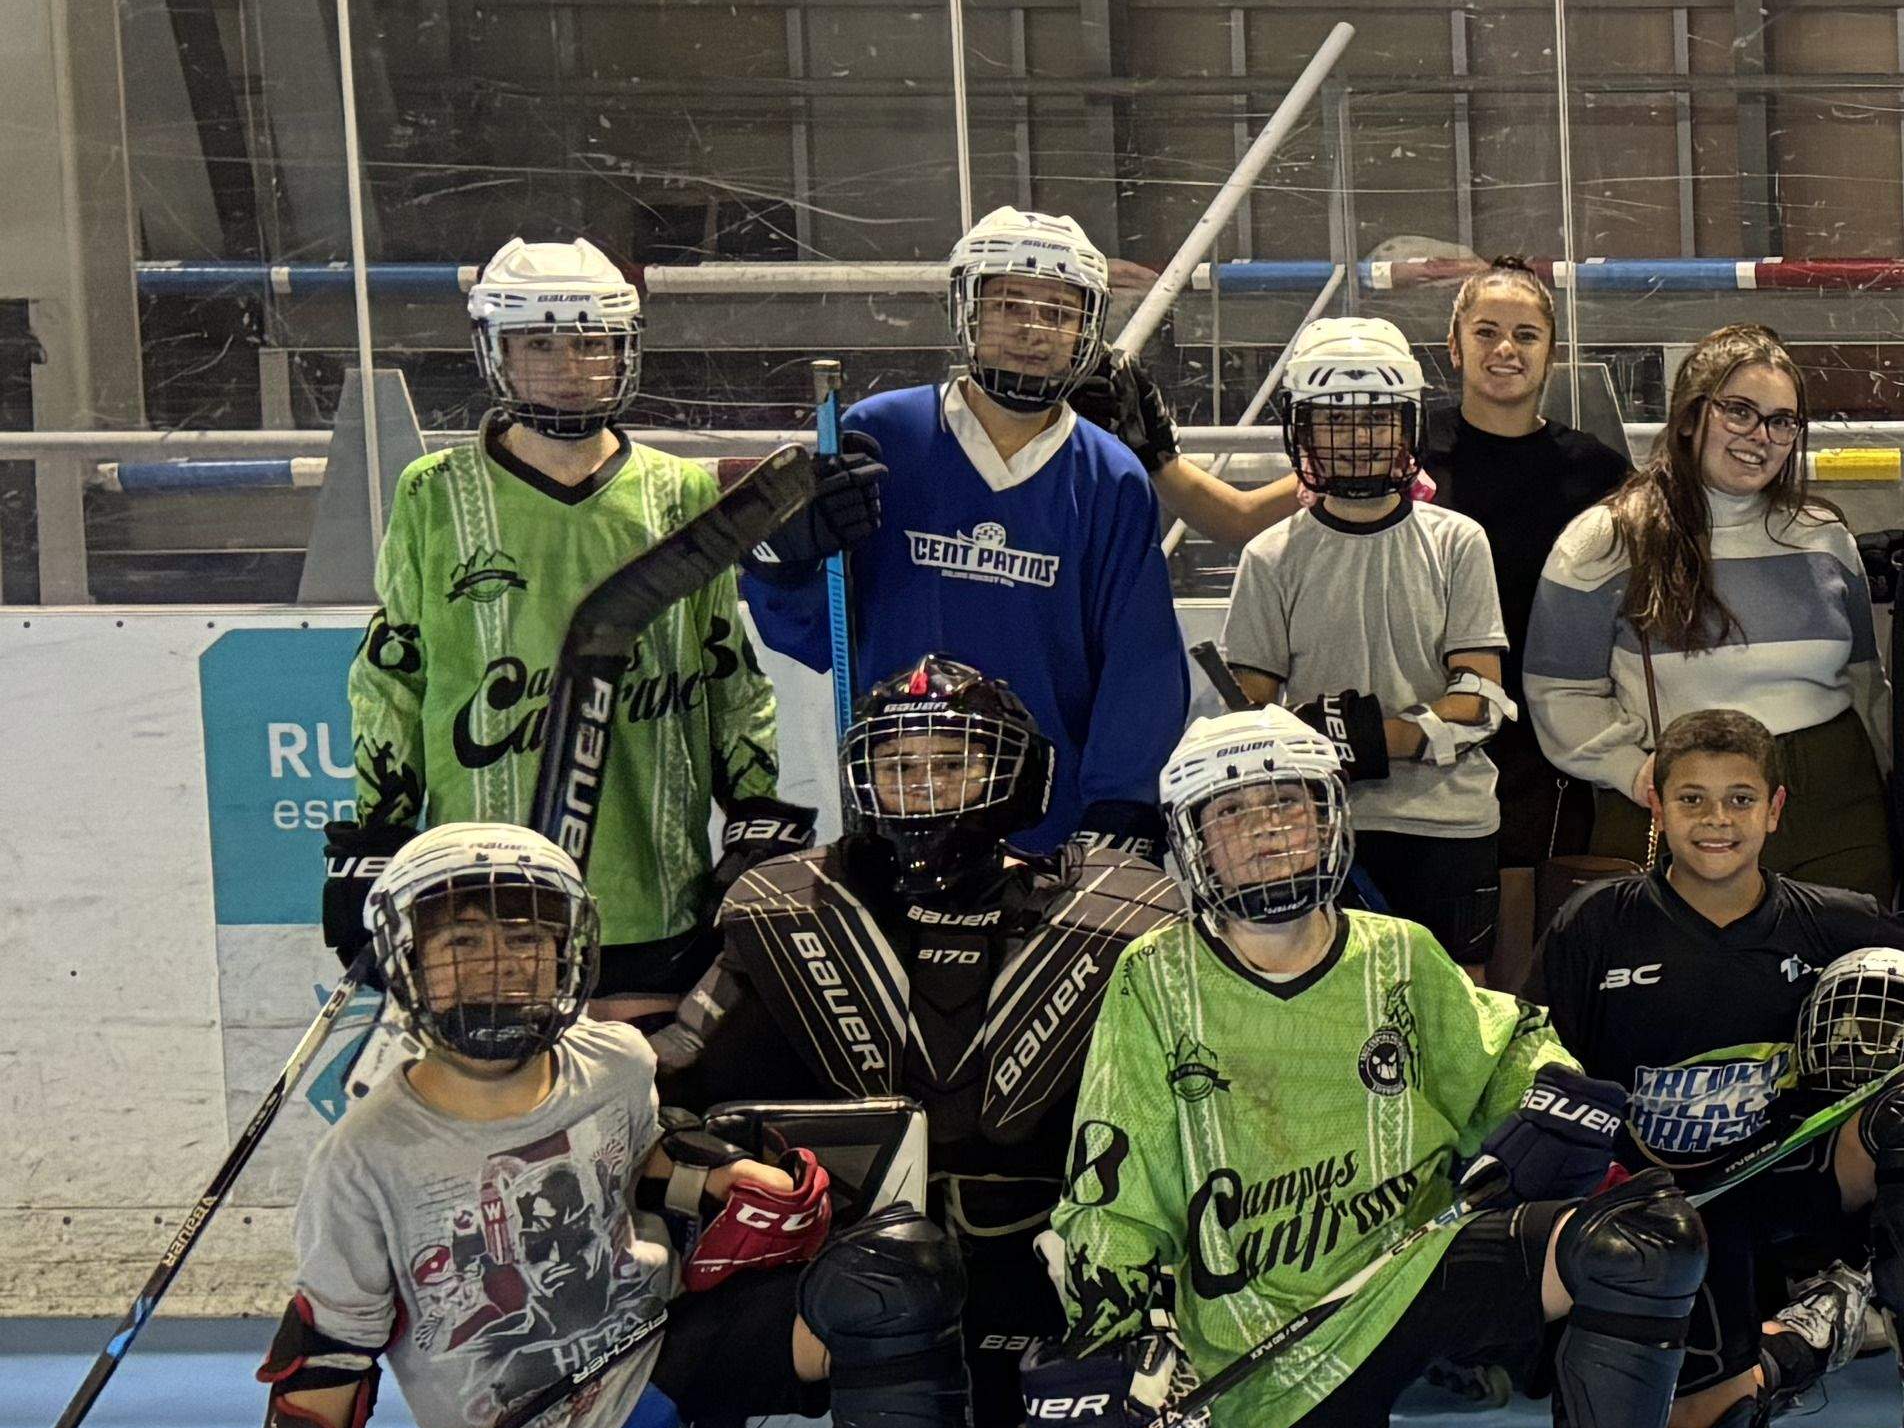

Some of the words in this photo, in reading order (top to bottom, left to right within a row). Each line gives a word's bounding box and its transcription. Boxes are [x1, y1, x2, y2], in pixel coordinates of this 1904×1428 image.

[913, 535, 973, 566] CENT
[976, 547, 1056, 583] PATINS
[558, 675, 613, 860] AUER
[906, 905, 1002, 928] BAUER
